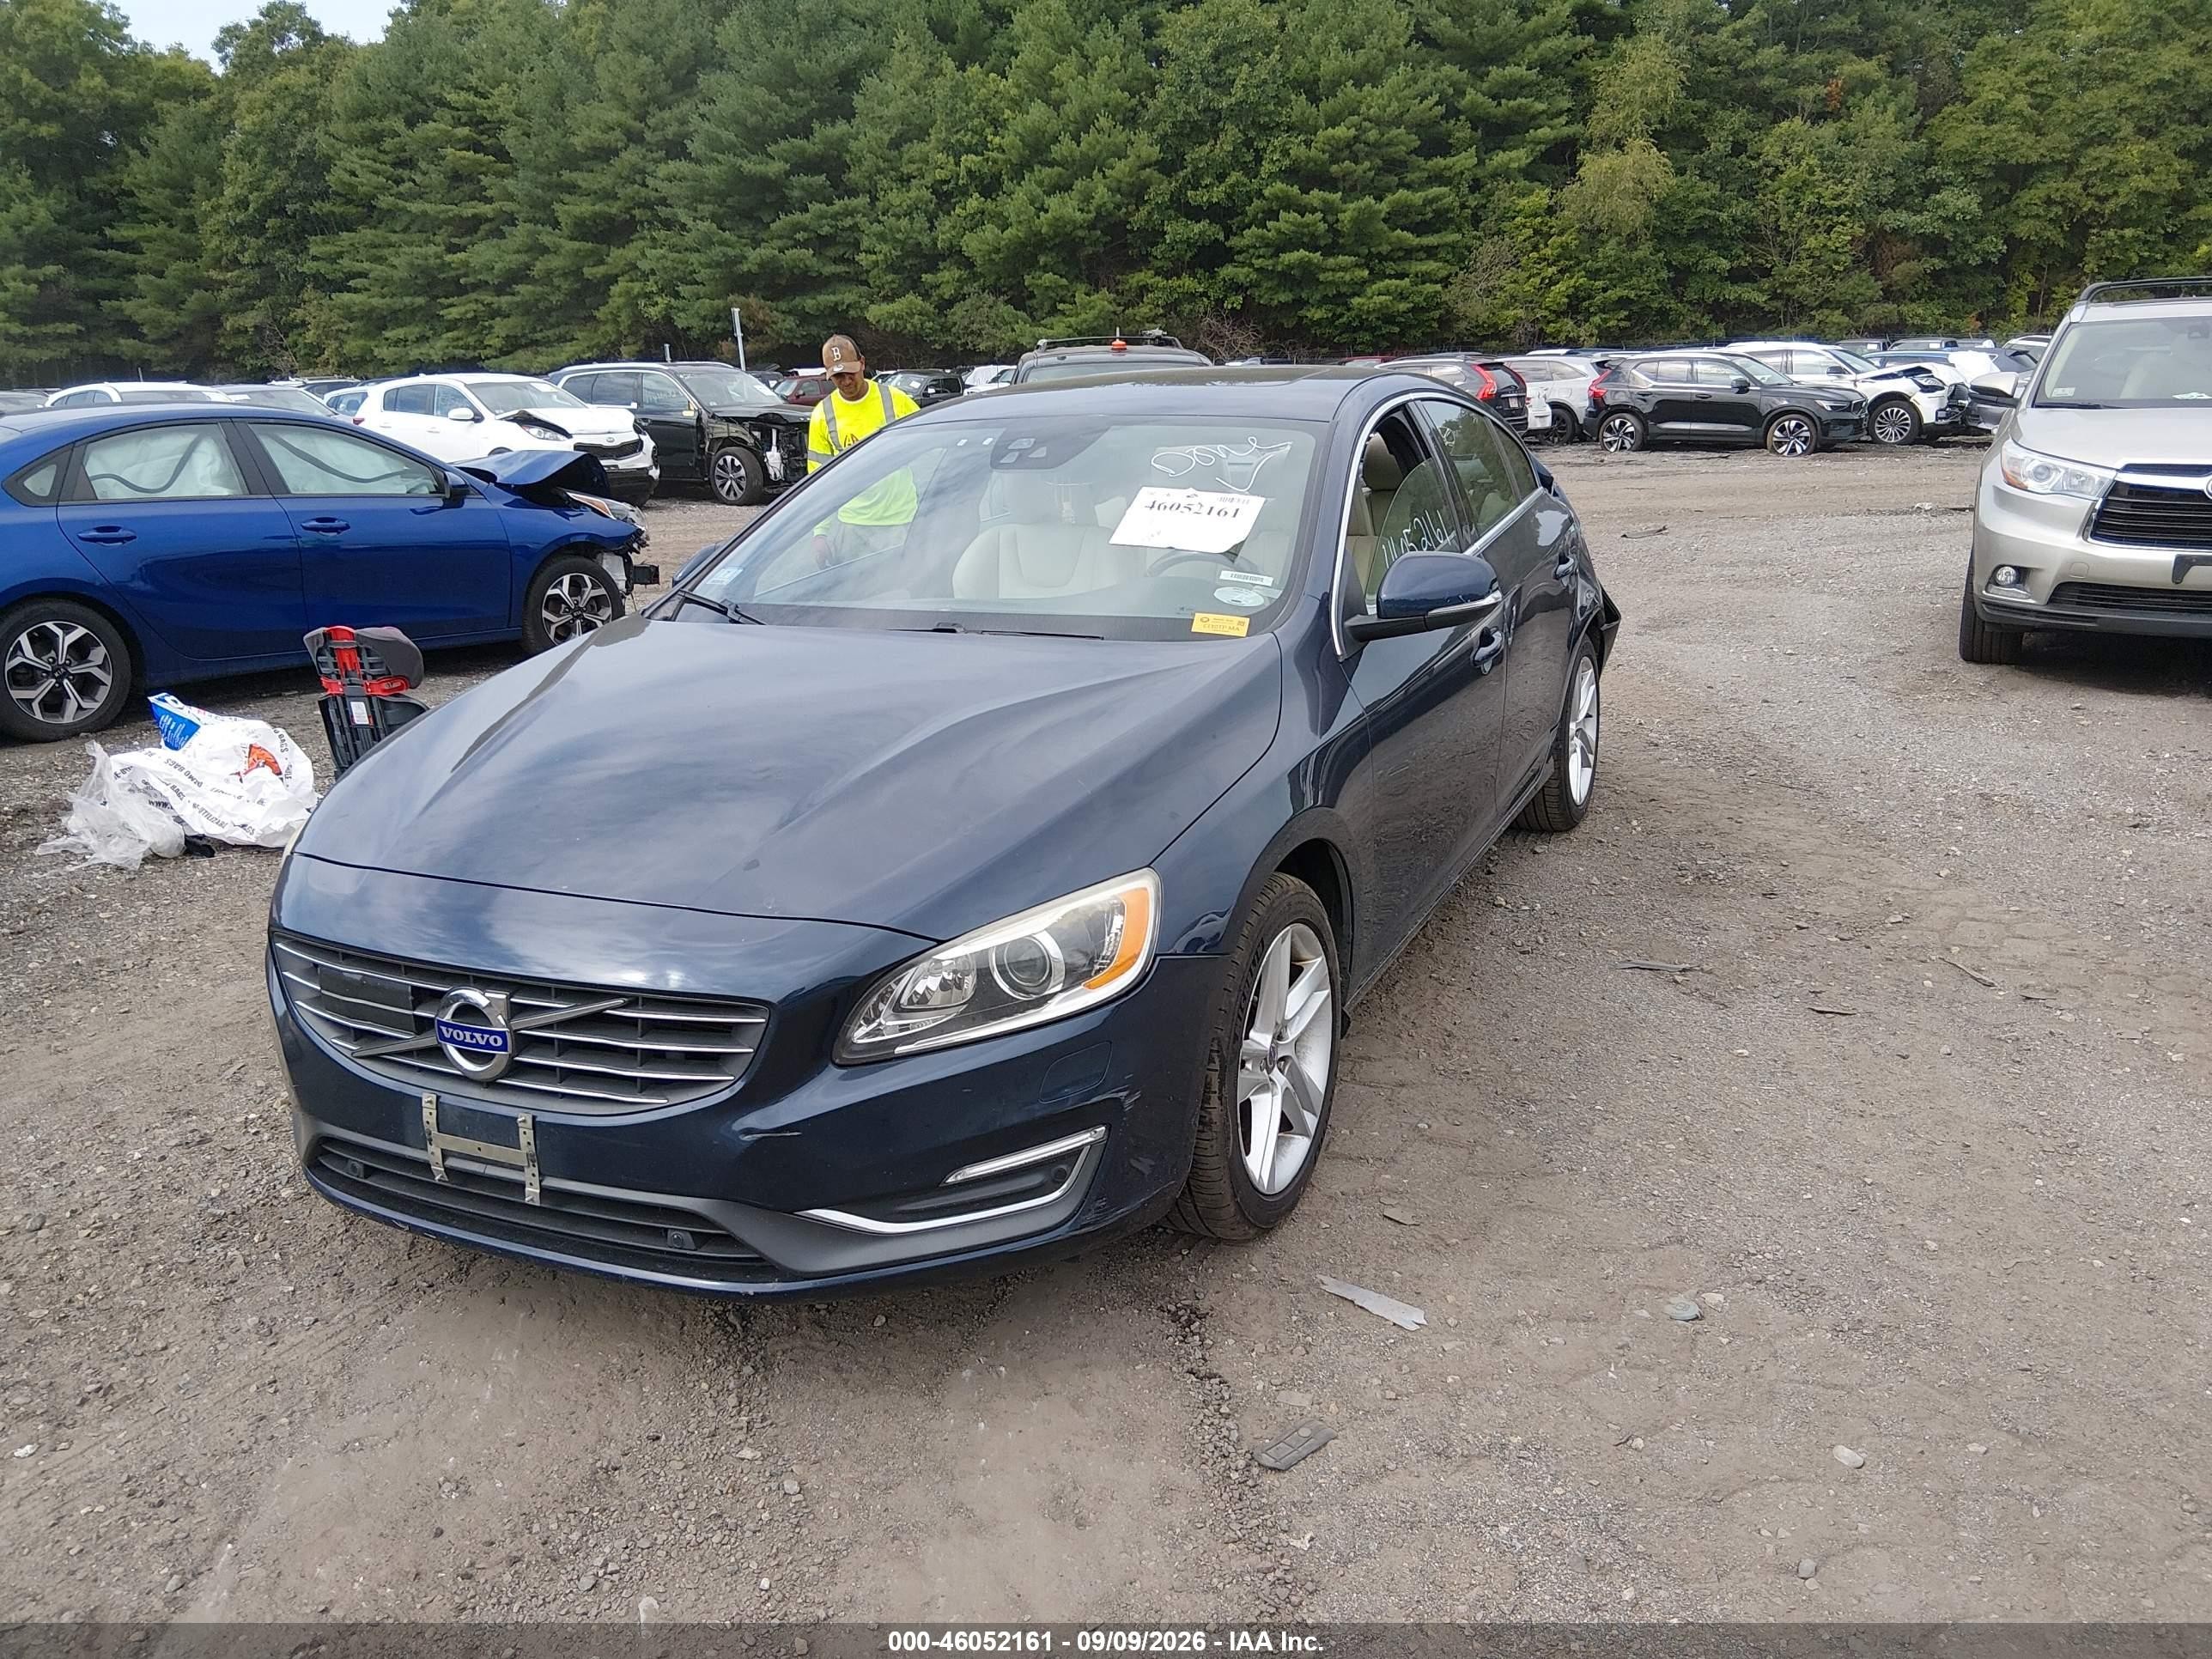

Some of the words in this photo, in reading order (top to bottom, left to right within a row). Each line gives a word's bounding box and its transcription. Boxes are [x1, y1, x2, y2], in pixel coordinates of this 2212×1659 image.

[831, 347, 842, 362] B
[1145, 500, 1240, 519] 46052161
[439, 1025, 503, 1047] VOLVO
